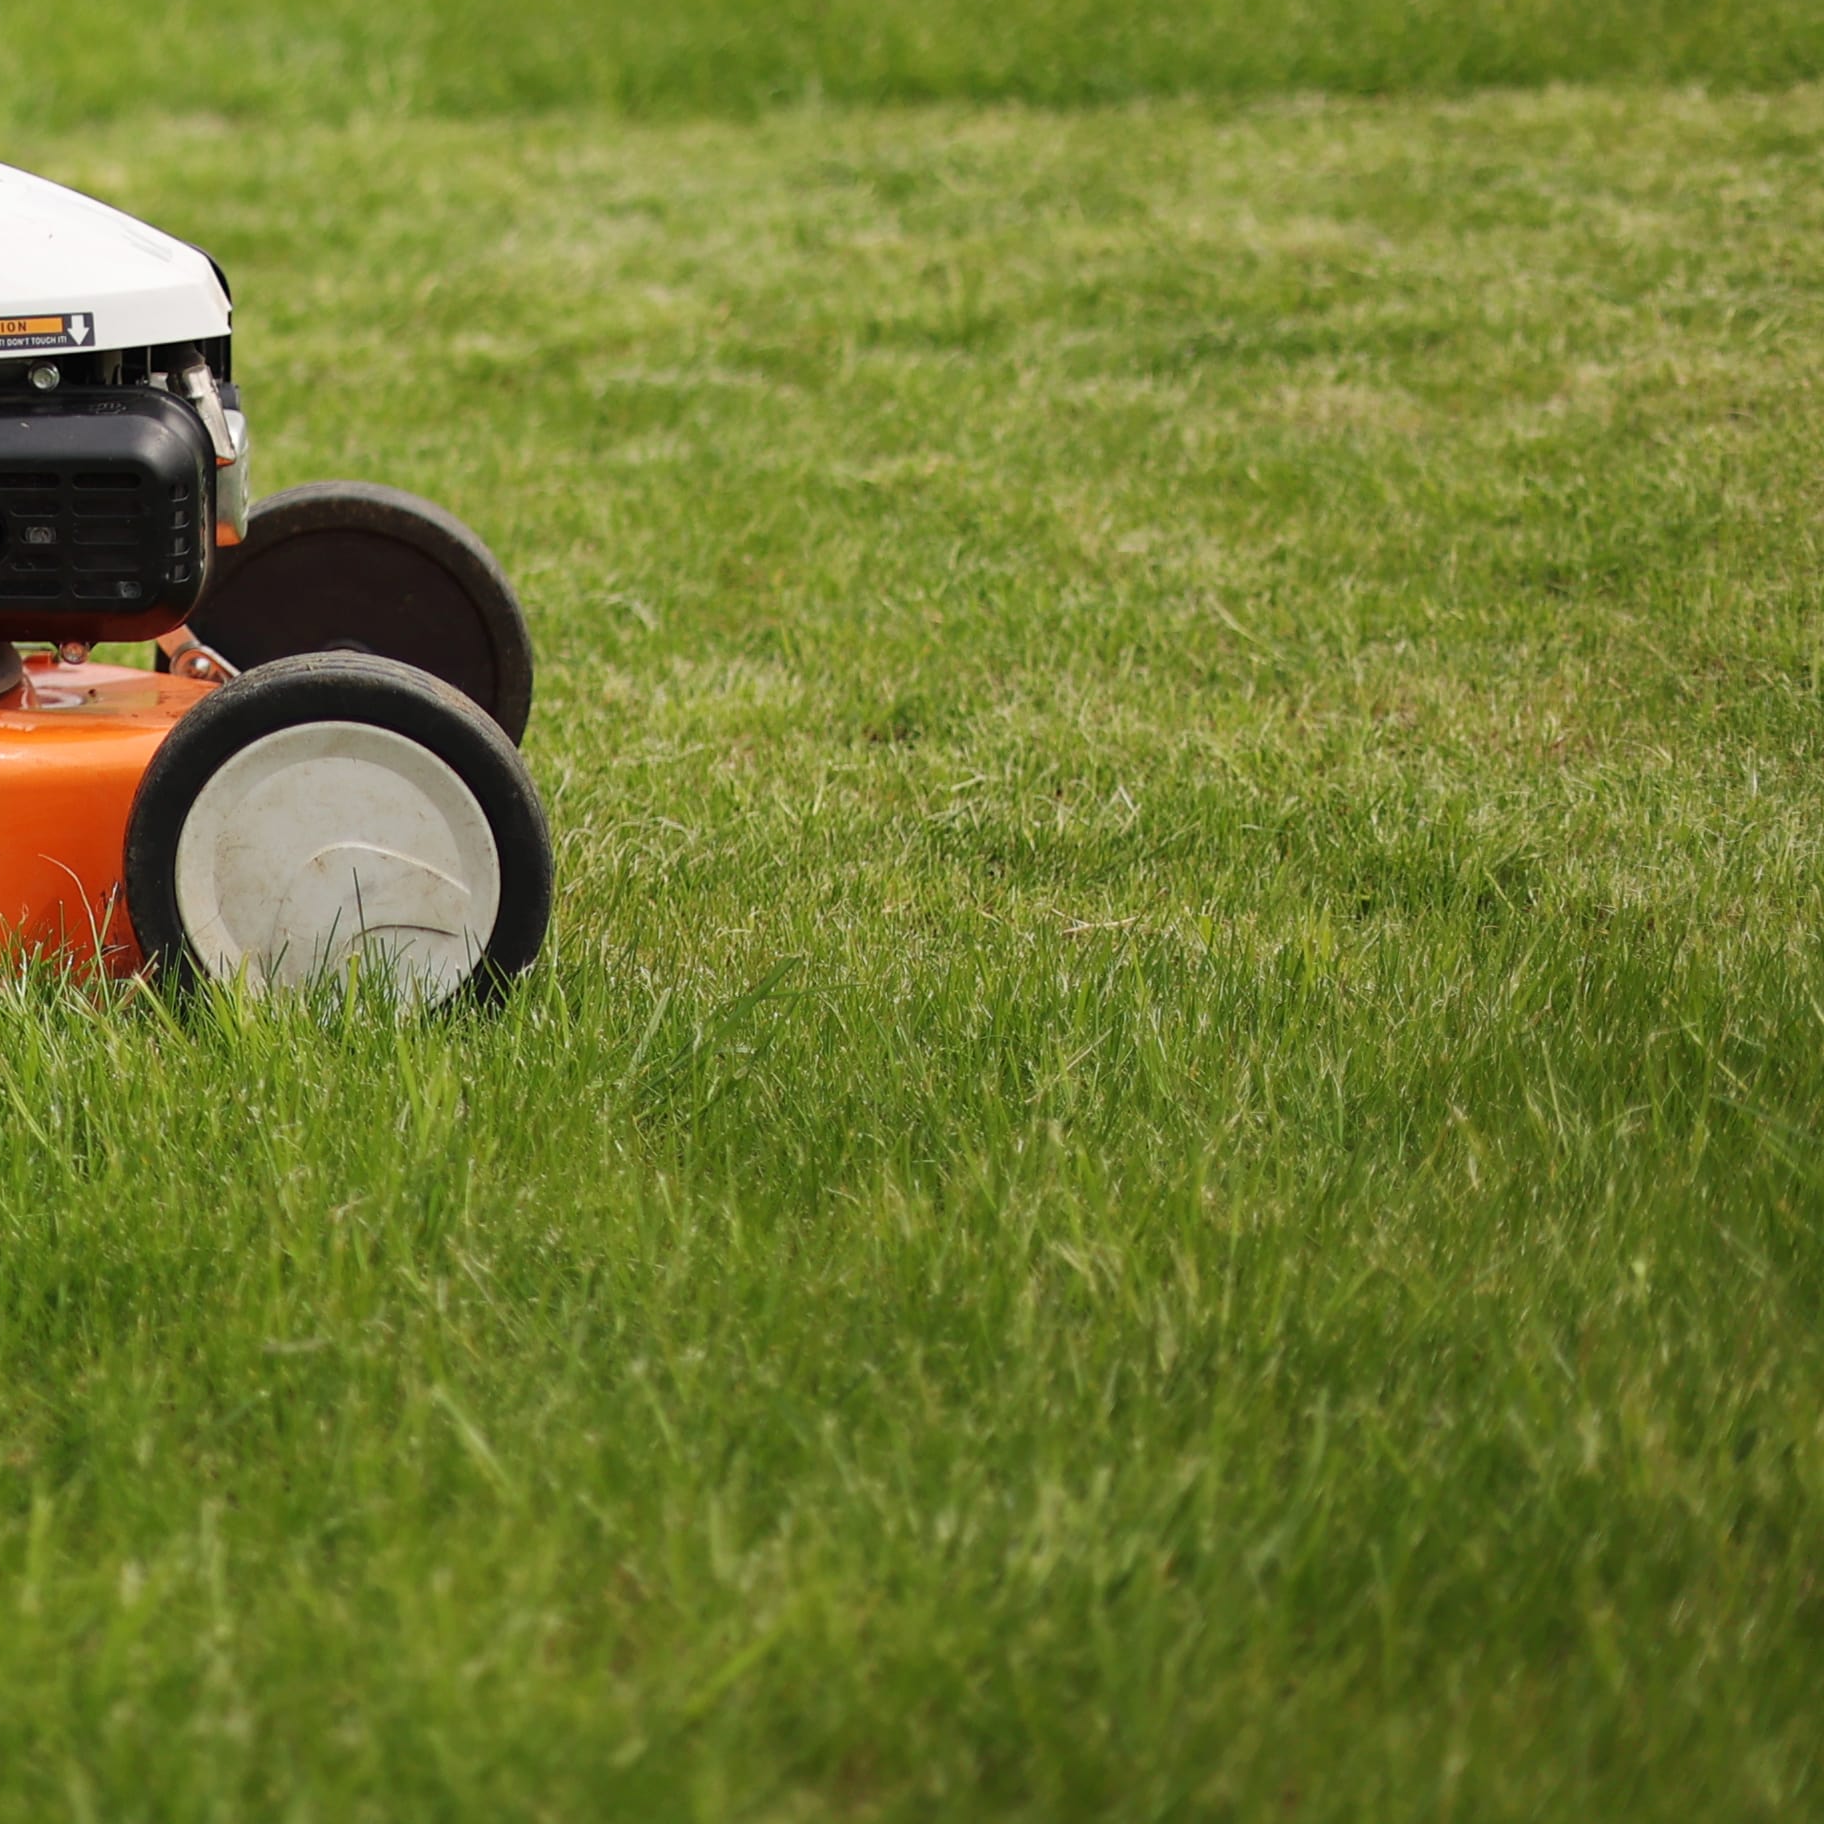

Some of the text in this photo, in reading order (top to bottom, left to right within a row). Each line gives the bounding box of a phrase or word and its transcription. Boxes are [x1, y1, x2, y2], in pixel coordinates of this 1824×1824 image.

[7, 337, 29, 346] DON'T
[32, 336, 56, 345] TOUCH
[57, 335, 67, 343] IT!
